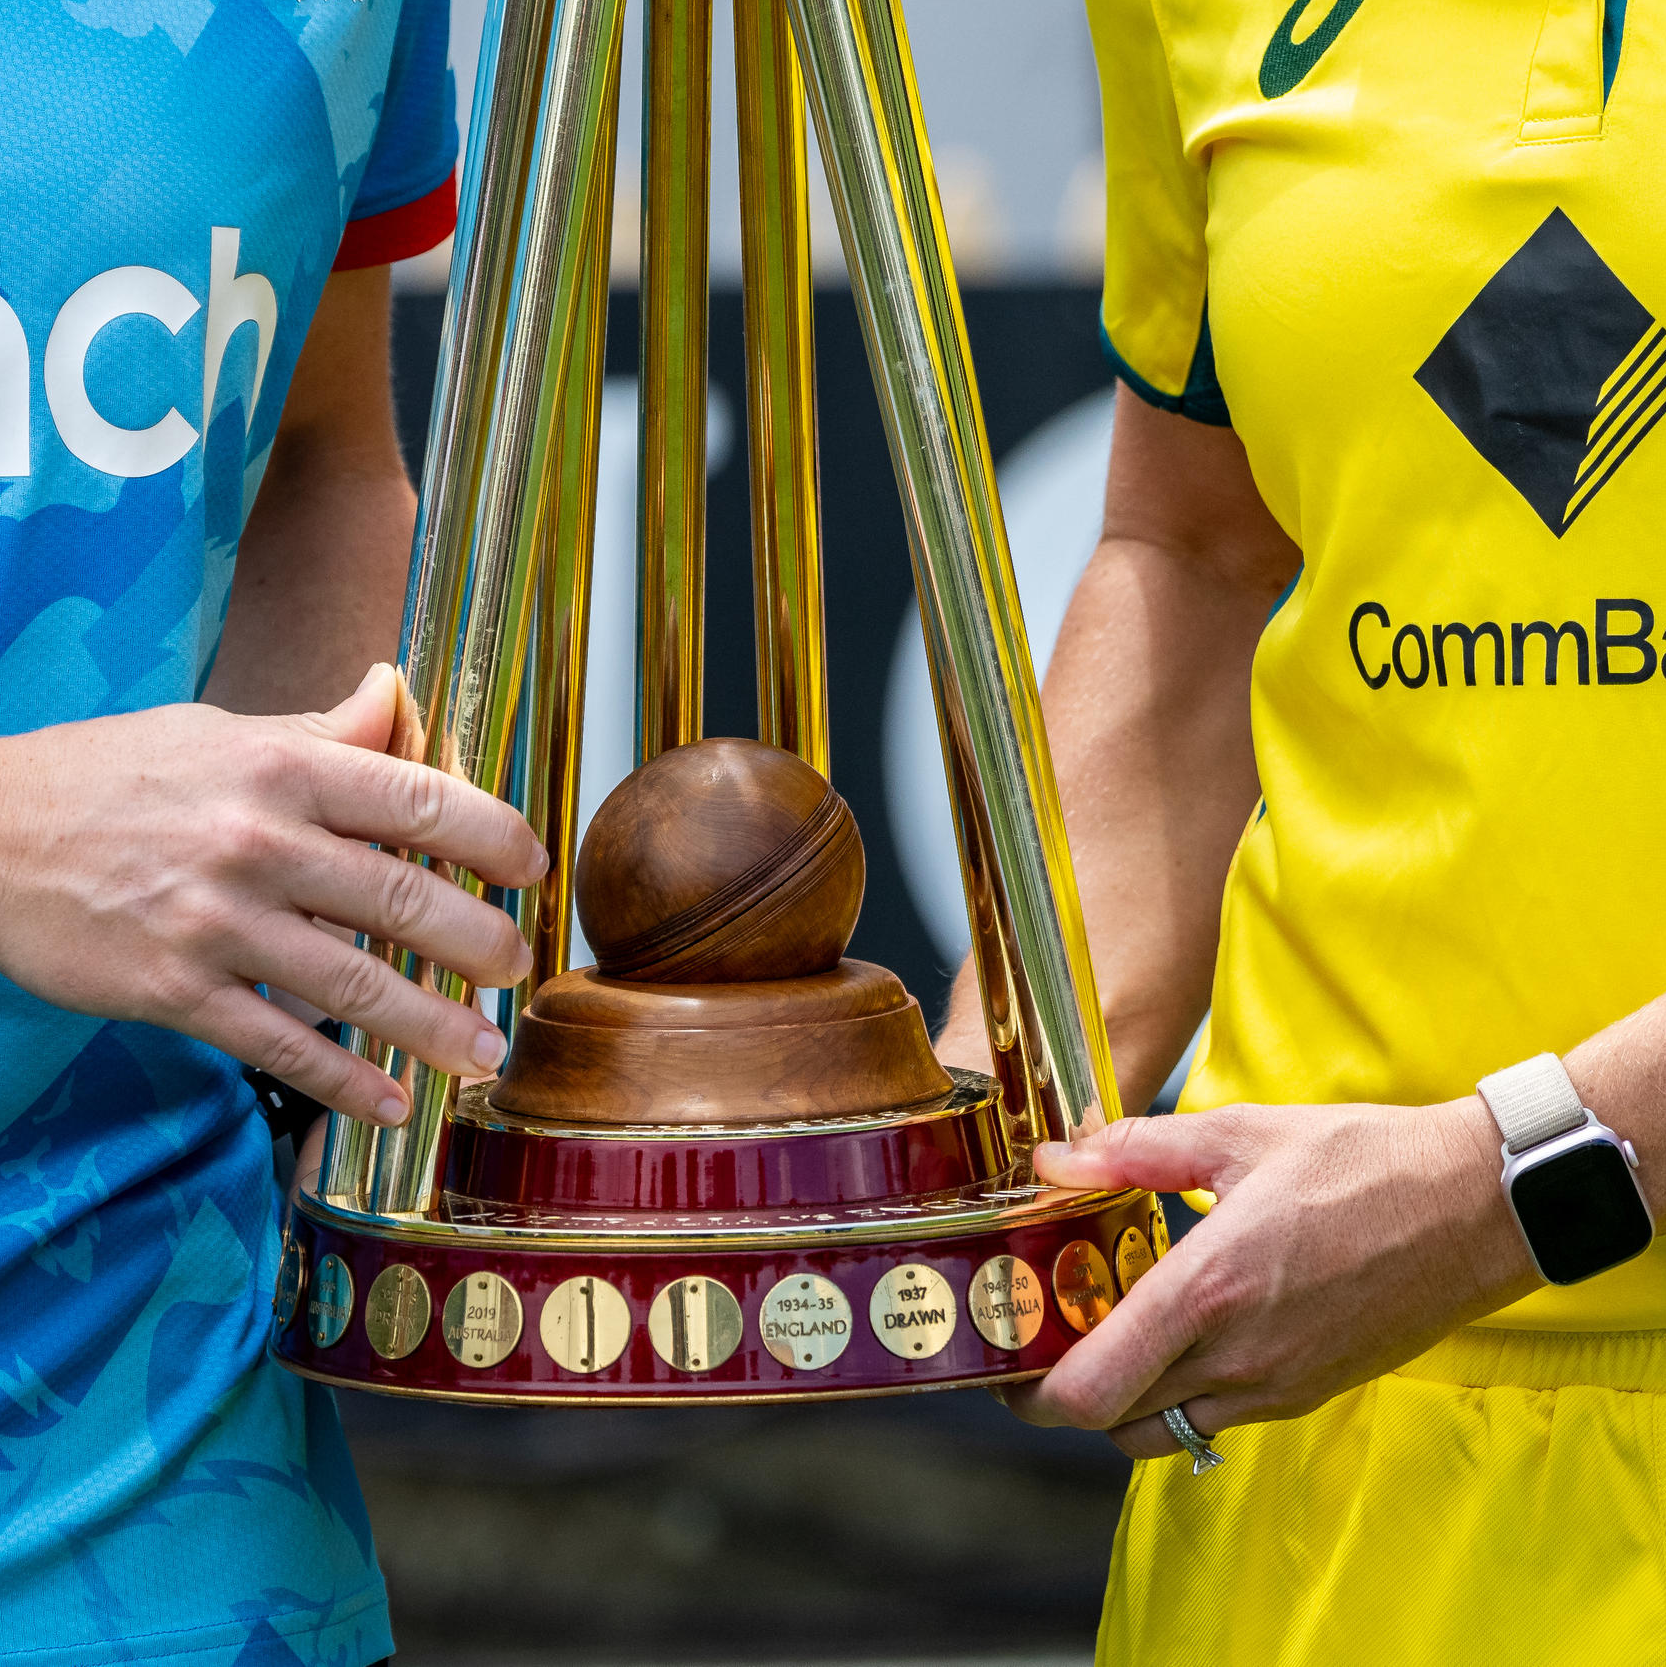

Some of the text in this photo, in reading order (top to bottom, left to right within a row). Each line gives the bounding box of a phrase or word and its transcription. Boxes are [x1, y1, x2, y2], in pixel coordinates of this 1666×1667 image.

[897, 1285, 927, 1302] 1937
[467, 1305, 496, 1320] 2019
[776, 1297, 835, 1313] 1934-35
[977, 1298, 1042, 1321] AUSTRALIA
[884, 1308, 946, 1330] DRAWN
[447, 1324, 514, 1343] AUSTRALIA
[765, 1318, 848, 1341] ENGLAND
